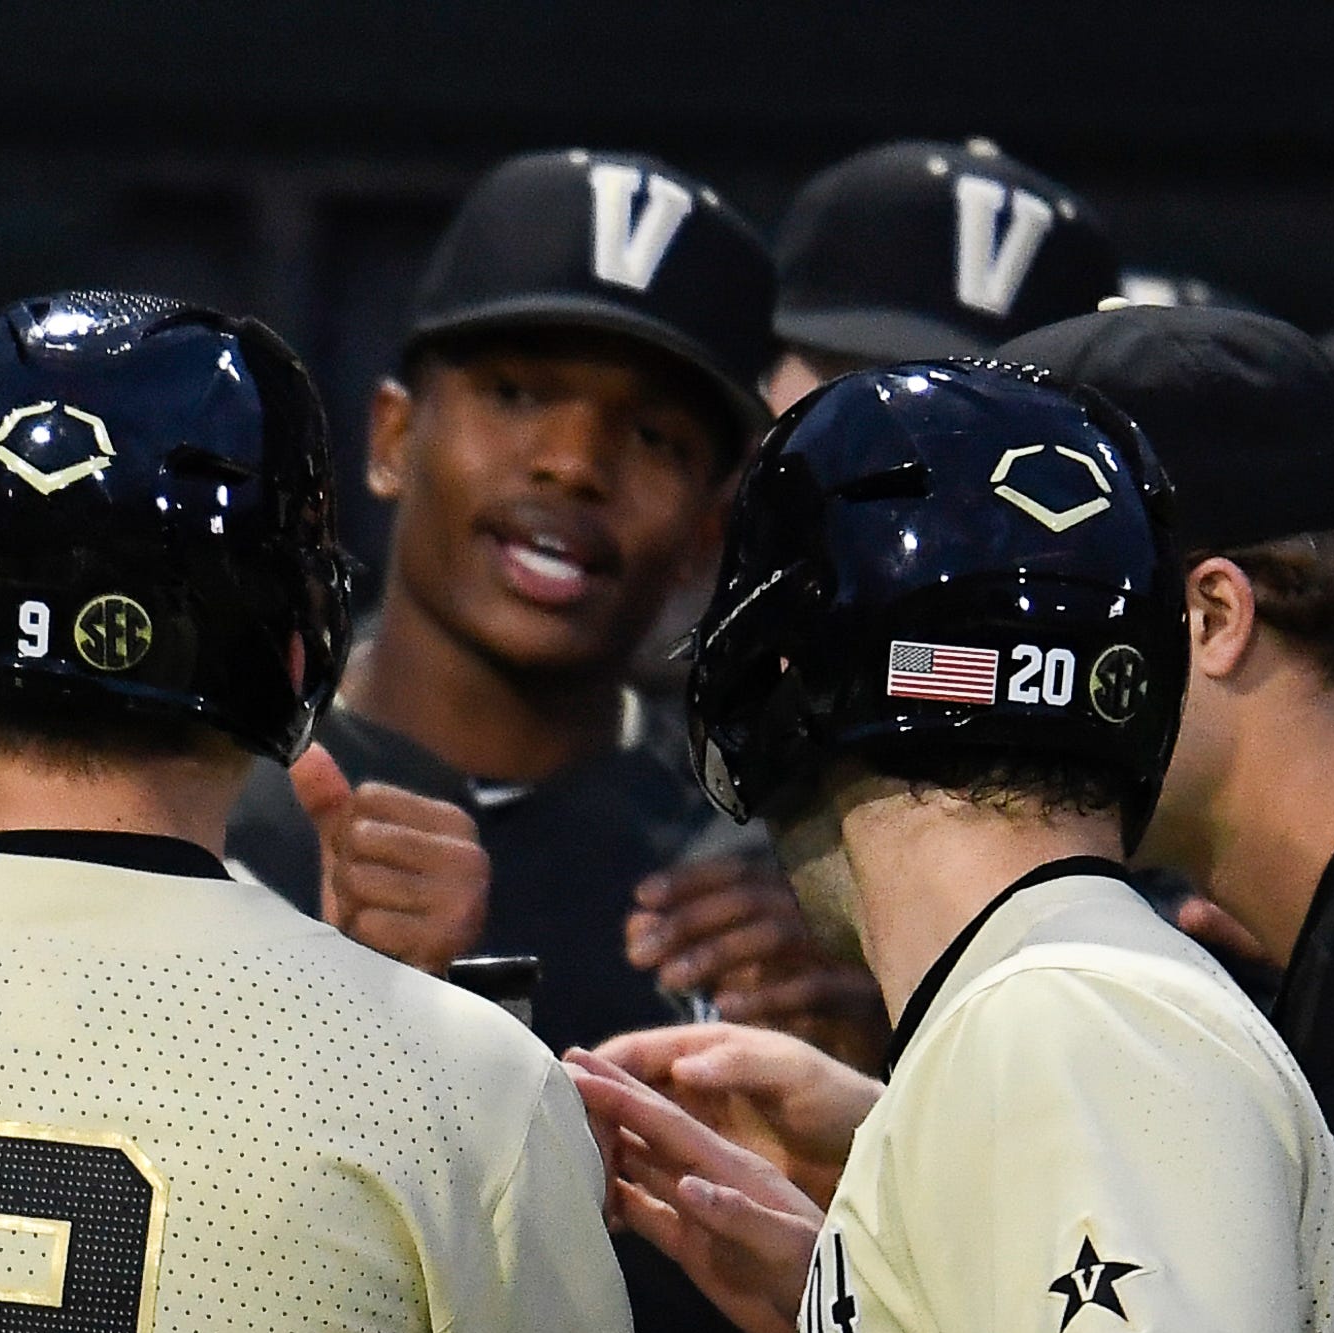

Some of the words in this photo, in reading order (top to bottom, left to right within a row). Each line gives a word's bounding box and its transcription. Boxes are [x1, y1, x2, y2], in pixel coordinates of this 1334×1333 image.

[592, 165, 692, 290] V
[956, 176, 1053, 315] V
[18, 600, 50, 658] 9
[75, 596, 151, 670] SEC
[1008, 643, 1076, 707] 20
[1070, 1263, 1106, 1303] V
